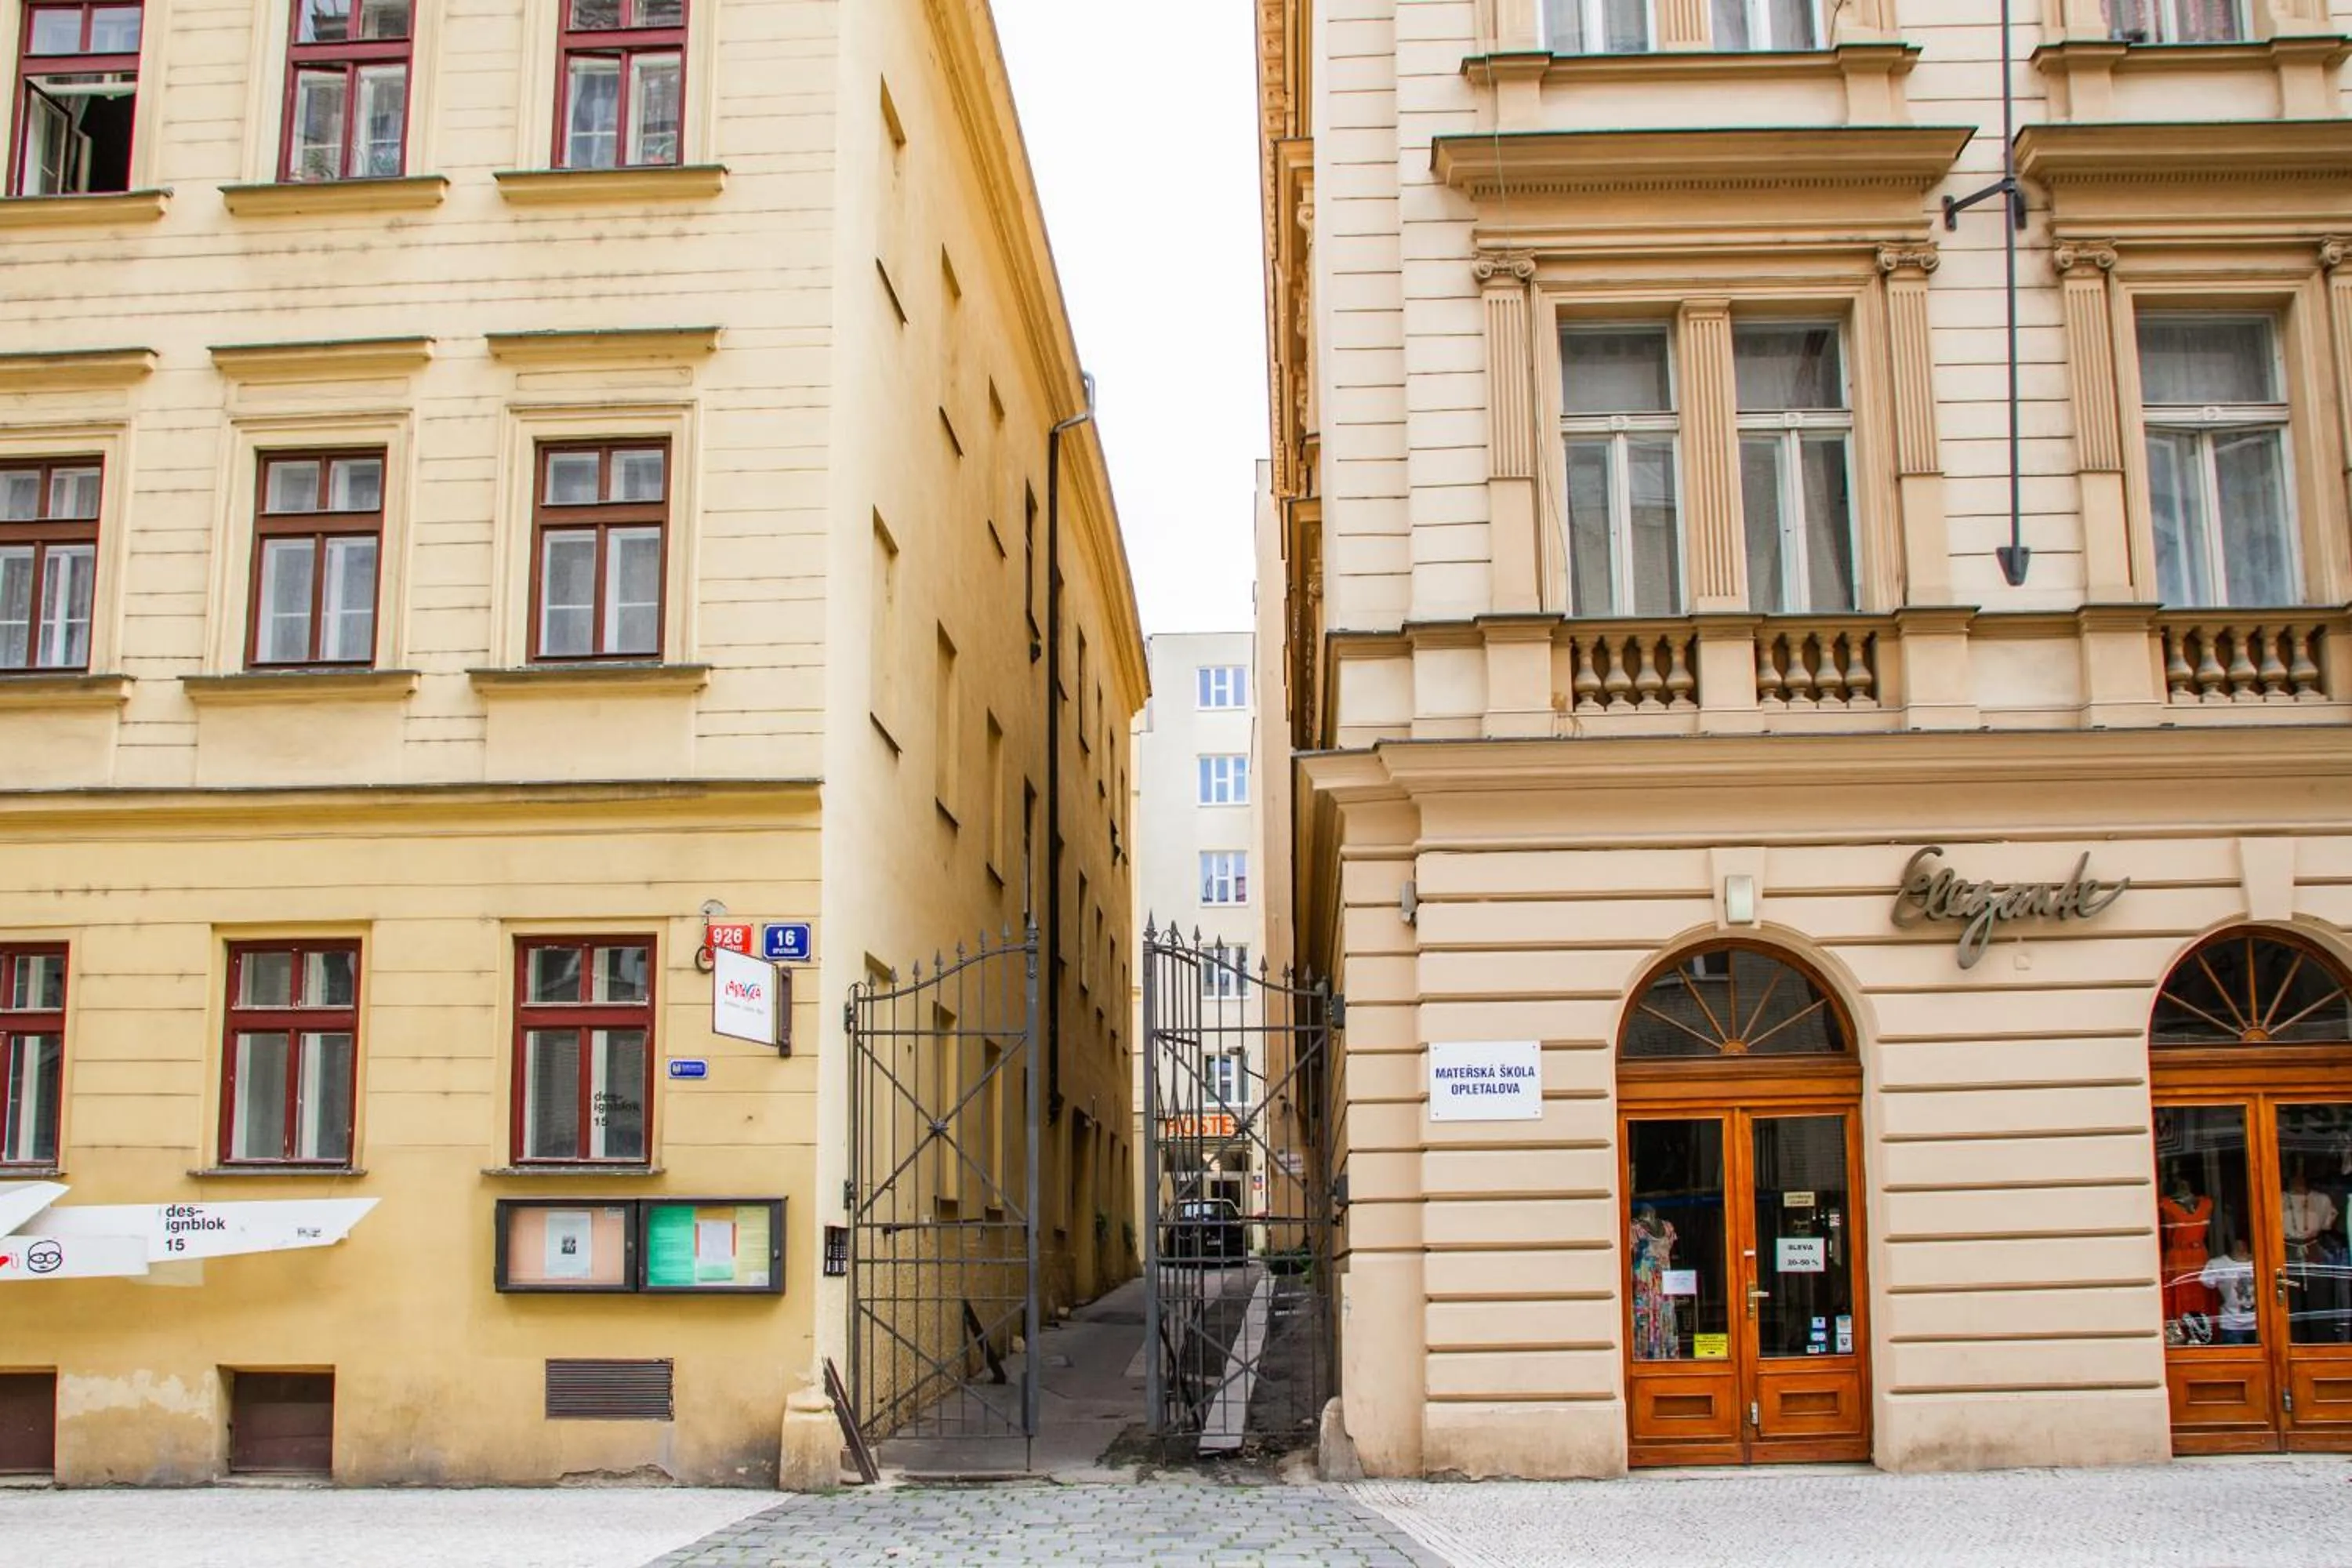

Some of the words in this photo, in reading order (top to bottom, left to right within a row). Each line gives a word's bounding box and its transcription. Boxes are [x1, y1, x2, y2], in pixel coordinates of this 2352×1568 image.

[713, 927, 743, 944] 926
[777, 929, 796, 946] 16
[1436, 1064, 1496, 1079] MATEŘSKÁ
[1499, 1063, 1536, 1078] ŠKOLA
[1450, 1083, 1520, 1095] OPLETALOVA
[1166, 1115, 1236, 1134] HOSTE
[165, 1204, 204, 1218] des-
[165, 1217, 226, 1233] ignblok
[165, 1238, 185, 1252] 15
